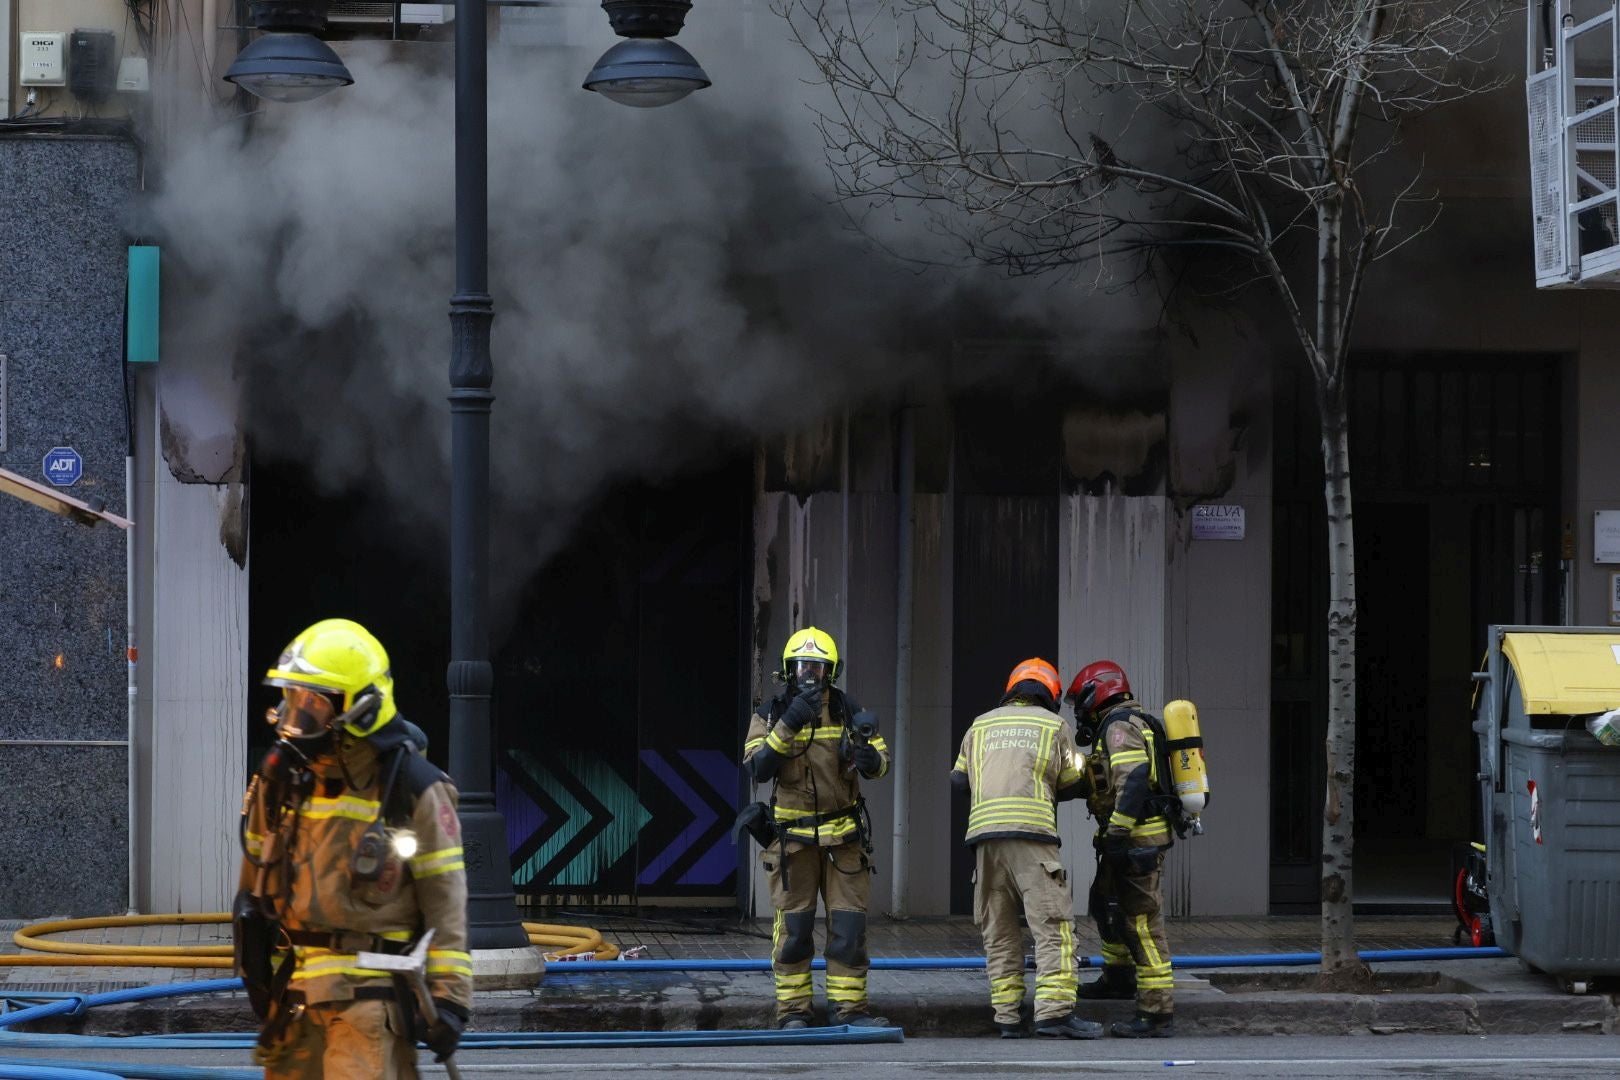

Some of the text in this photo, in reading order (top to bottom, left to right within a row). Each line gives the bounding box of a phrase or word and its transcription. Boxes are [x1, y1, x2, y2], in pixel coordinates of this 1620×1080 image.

[50, 458, 75, 471] ADT
[1196, 505, 1241, 517] ZULVA
[985, 728, 1039, 740] BOMBERS
